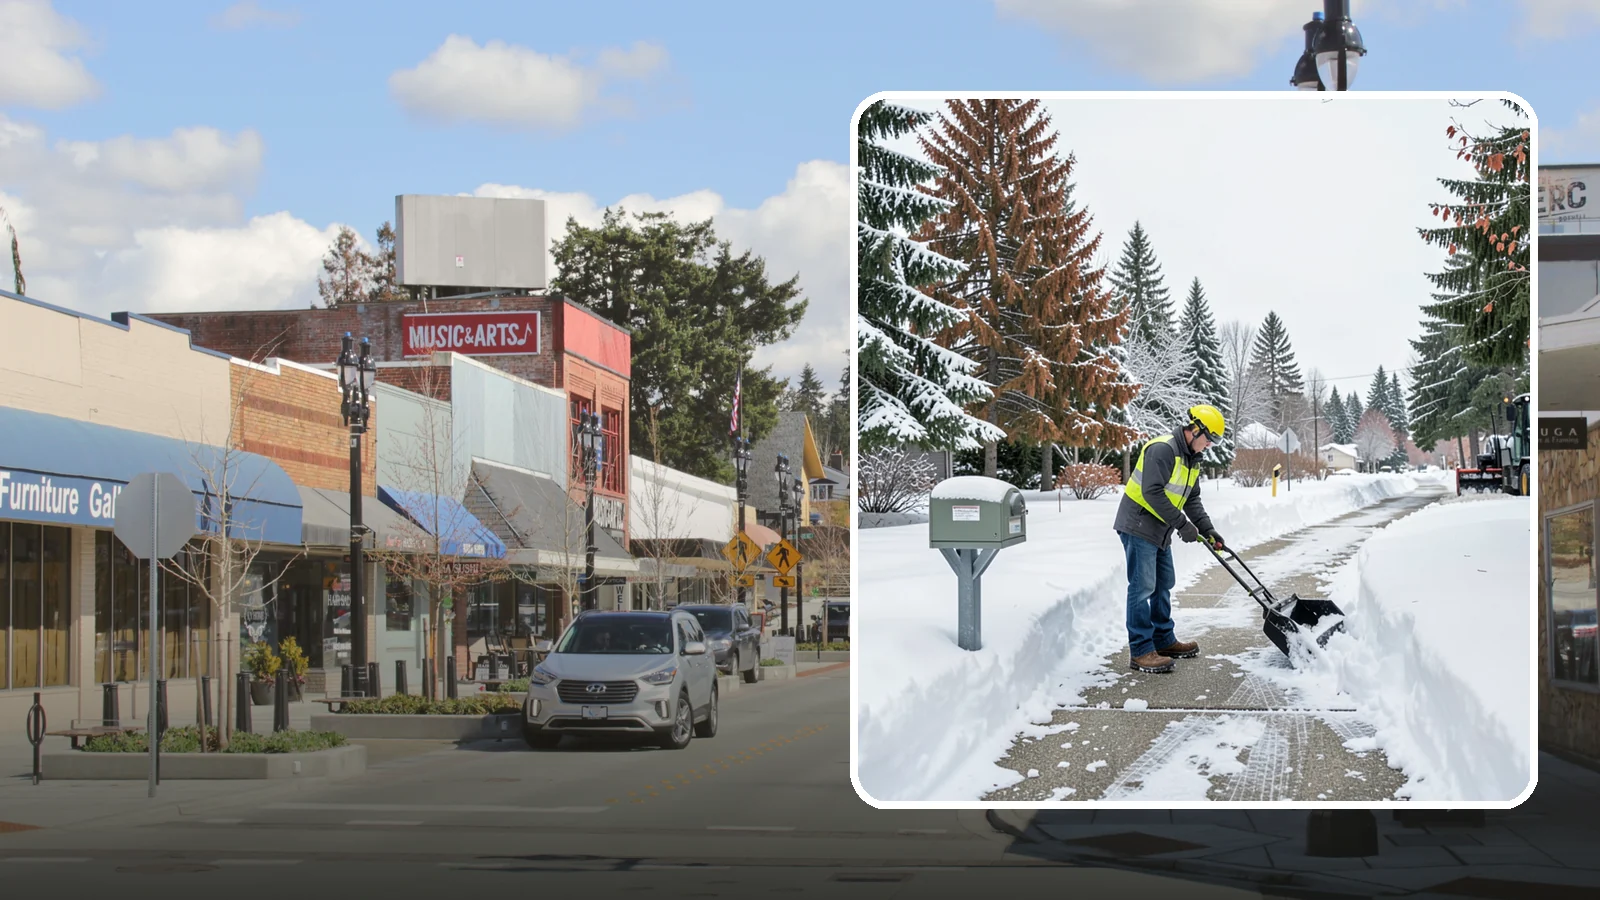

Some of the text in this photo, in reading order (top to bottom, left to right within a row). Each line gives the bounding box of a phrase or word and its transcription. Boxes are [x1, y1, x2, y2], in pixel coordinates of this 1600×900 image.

[1540, 427, 1577, 436] UGA
[0, 471, 121, 518] Furniture Gal
[453, 562, 479, 574] SUSHI
